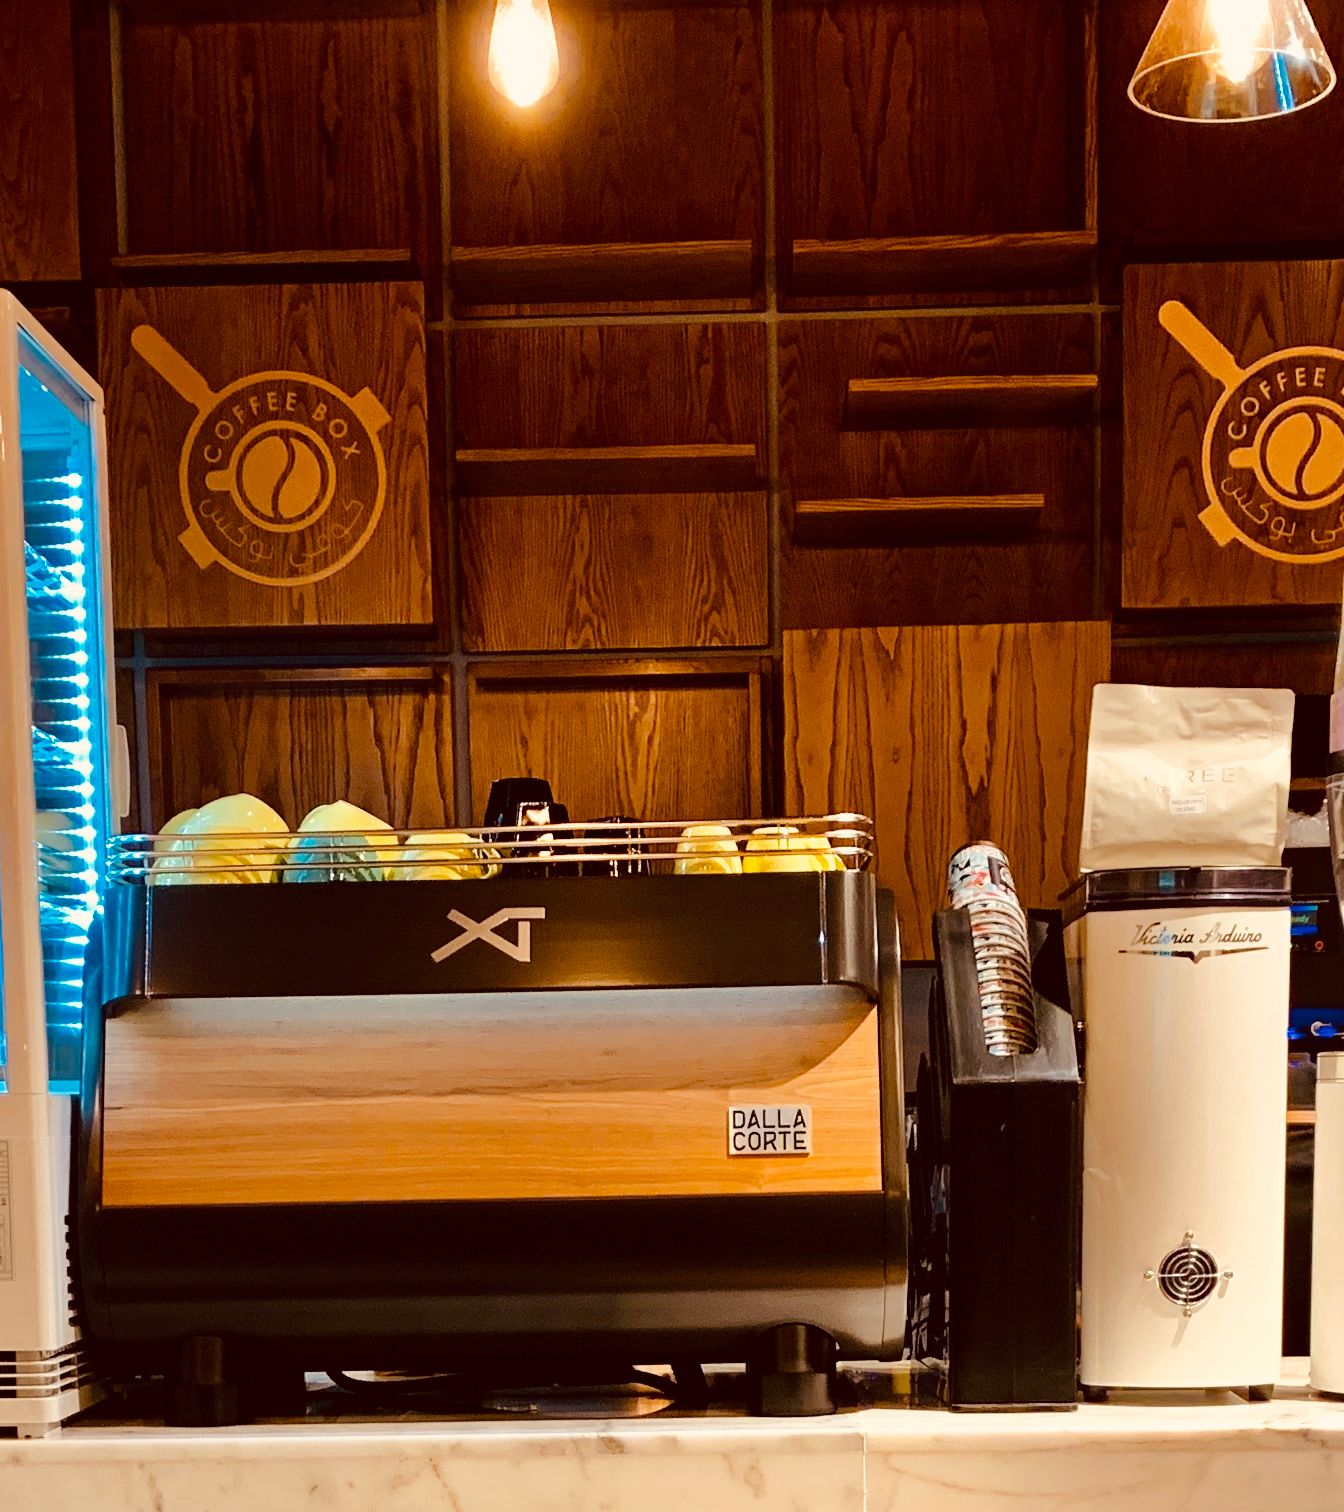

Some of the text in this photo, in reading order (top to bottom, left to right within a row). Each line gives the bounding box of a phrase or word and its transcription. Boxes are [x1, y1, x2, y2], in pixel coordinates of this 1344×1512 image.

[1227, 366, 1327, 440] COFFEE
[203, 390, 362, 463] COFFEE BOX
[1131, 921, 1263, 946] Victoria Arduino
[732, 1109, 807, 1129] DALLA
[732, 1131, 807, 1151] CORTE
